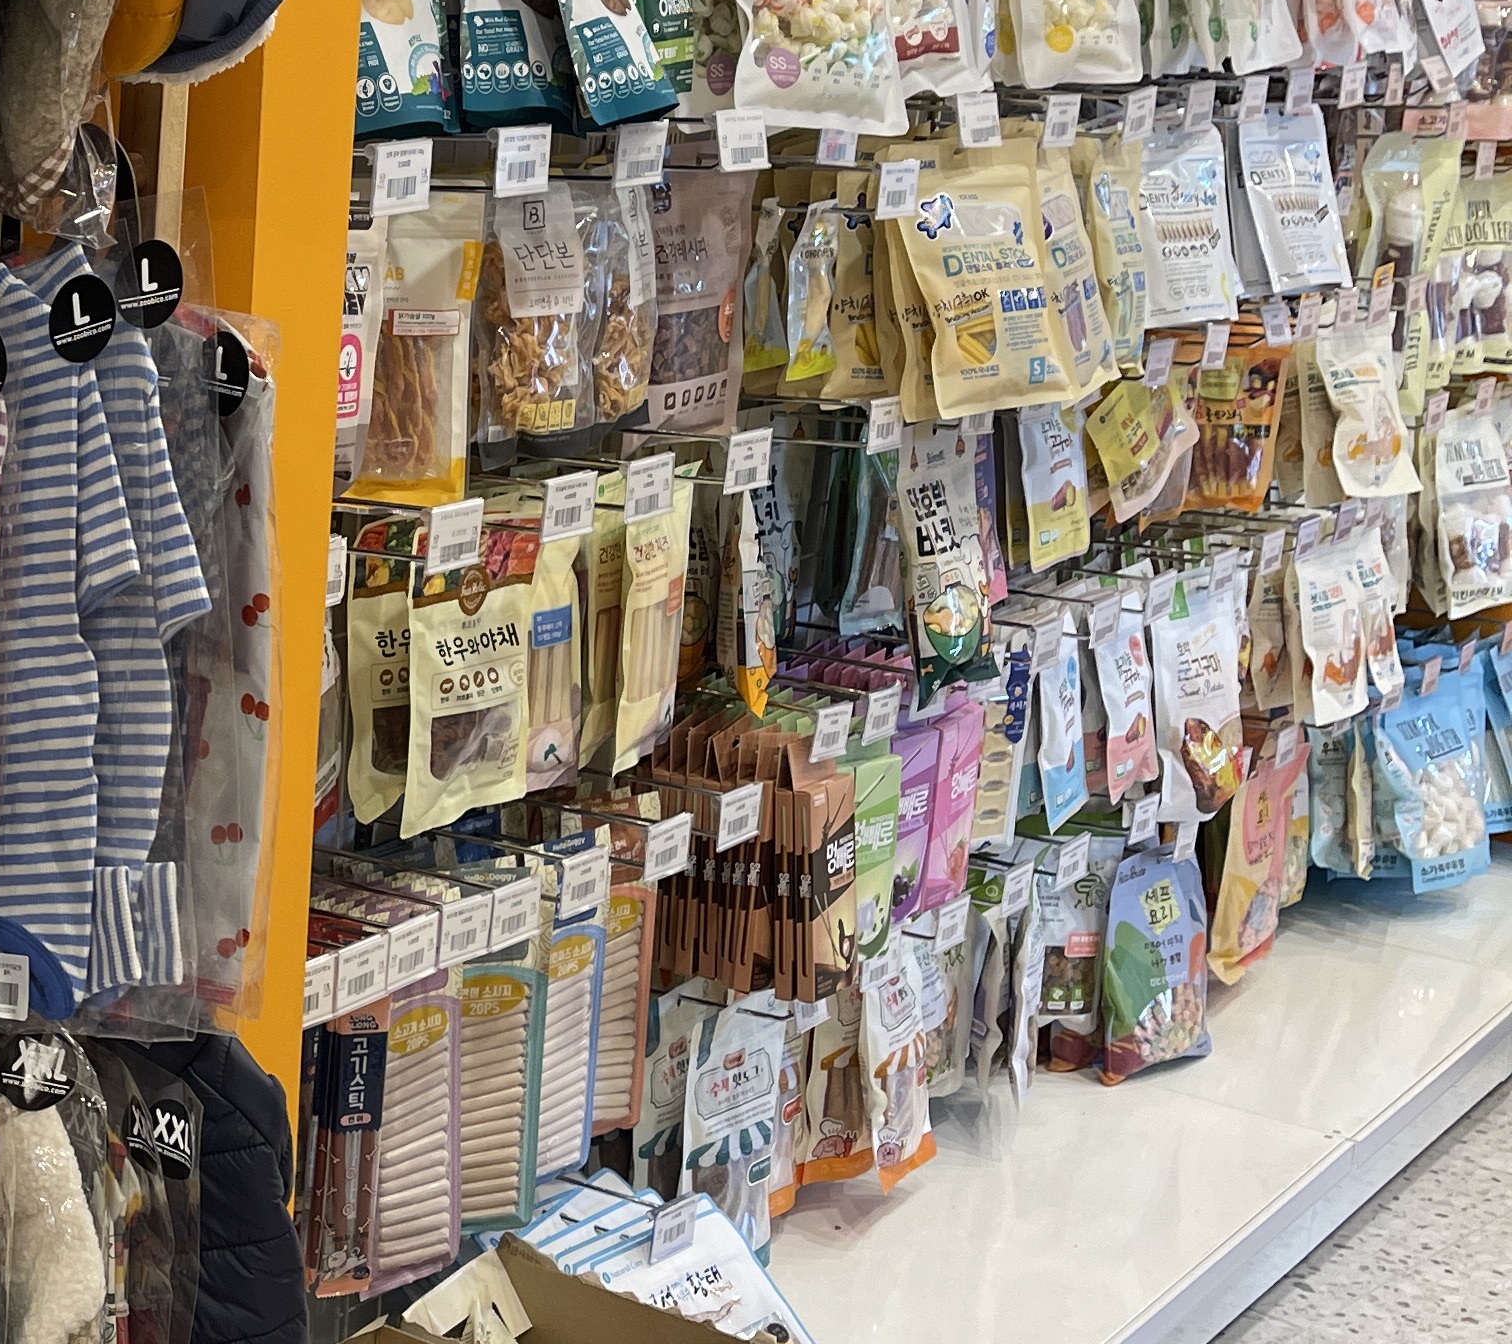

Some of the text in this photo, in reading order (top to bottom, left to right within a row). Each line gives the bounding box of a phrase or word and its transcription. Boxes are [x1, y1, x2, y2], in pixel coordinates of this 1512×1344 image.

[769, 56, 788, 70] SS
[1465, 221, 1489, 240] DOG
[512, 241, 575, 272] 단단본
[141, 257, 158, 292] L
[72, 293, 90, 327] L
[215, 346, 229, 381] L
[1148, 906, 1174, 926] 요리
[482, 983, 513, 998] 소시지
[469, 1001, 500, 1016] 20PS
[419, 1013, 442, 1033] 소시지
[348, 1037, 370, 1111] 고기스틱
